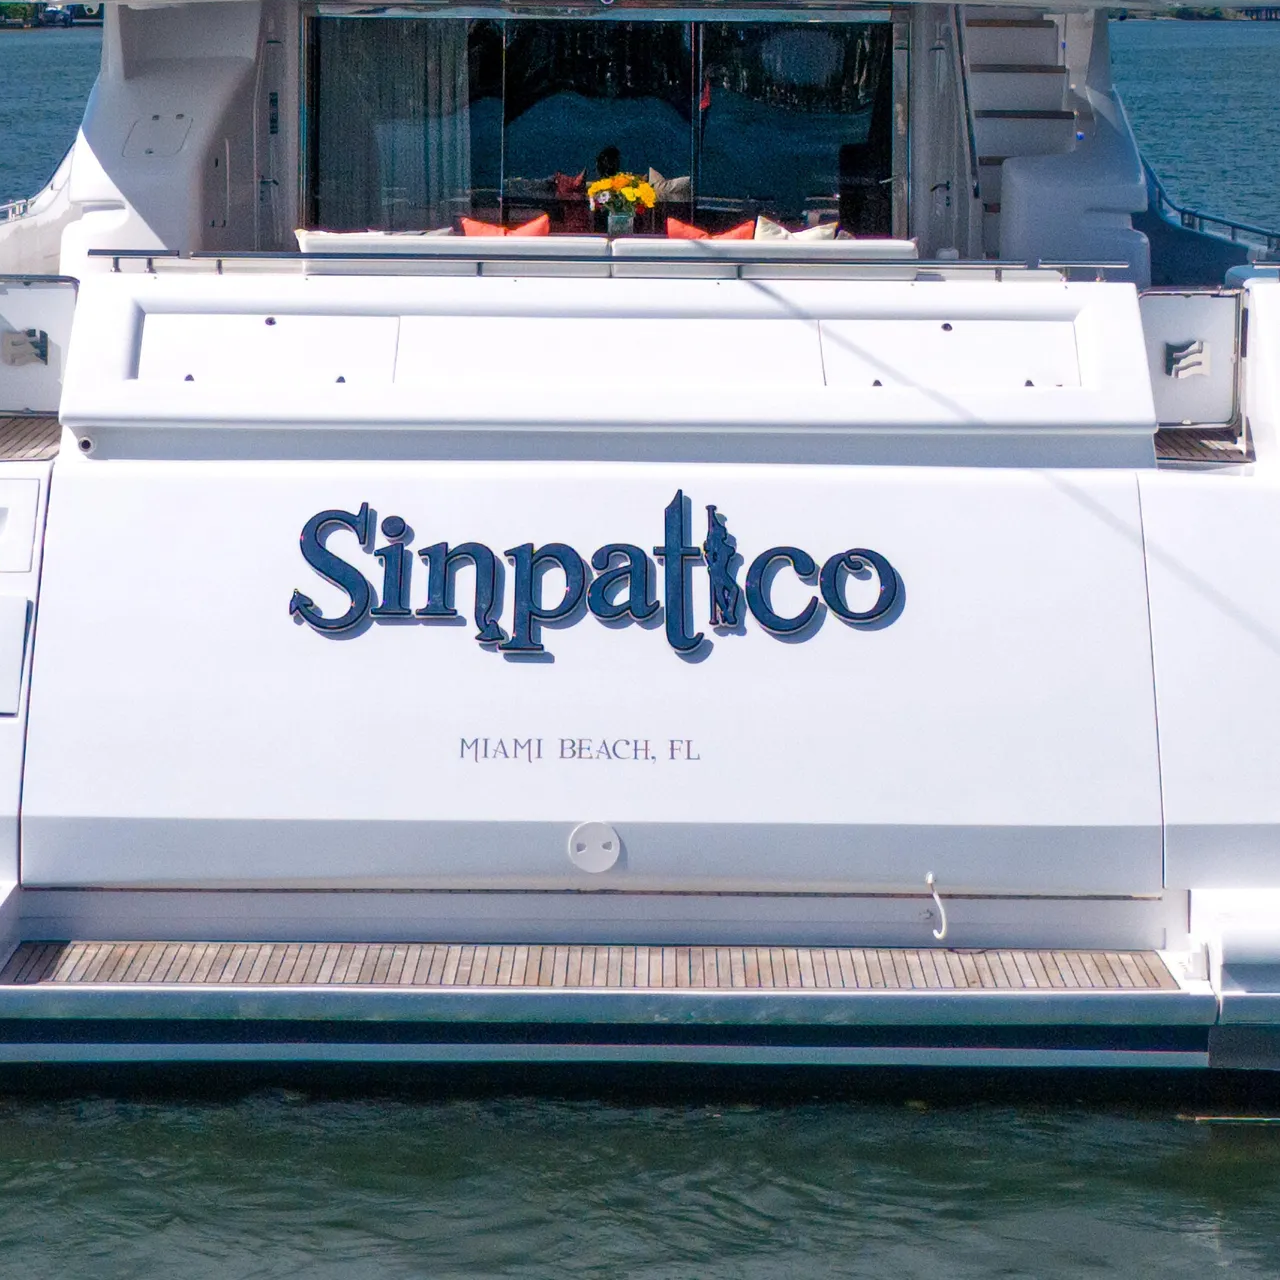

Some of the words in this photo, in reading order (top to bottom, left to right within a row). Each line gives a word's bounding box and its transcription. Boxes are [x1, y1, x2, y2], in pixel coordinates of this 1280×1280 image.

[289, 489, 898, 652] Sinpatico
[459, 737, 543, 763] MIAMI
[558, 738, 657, 764] BEACH,
[669, 738, 701, 761] FL
